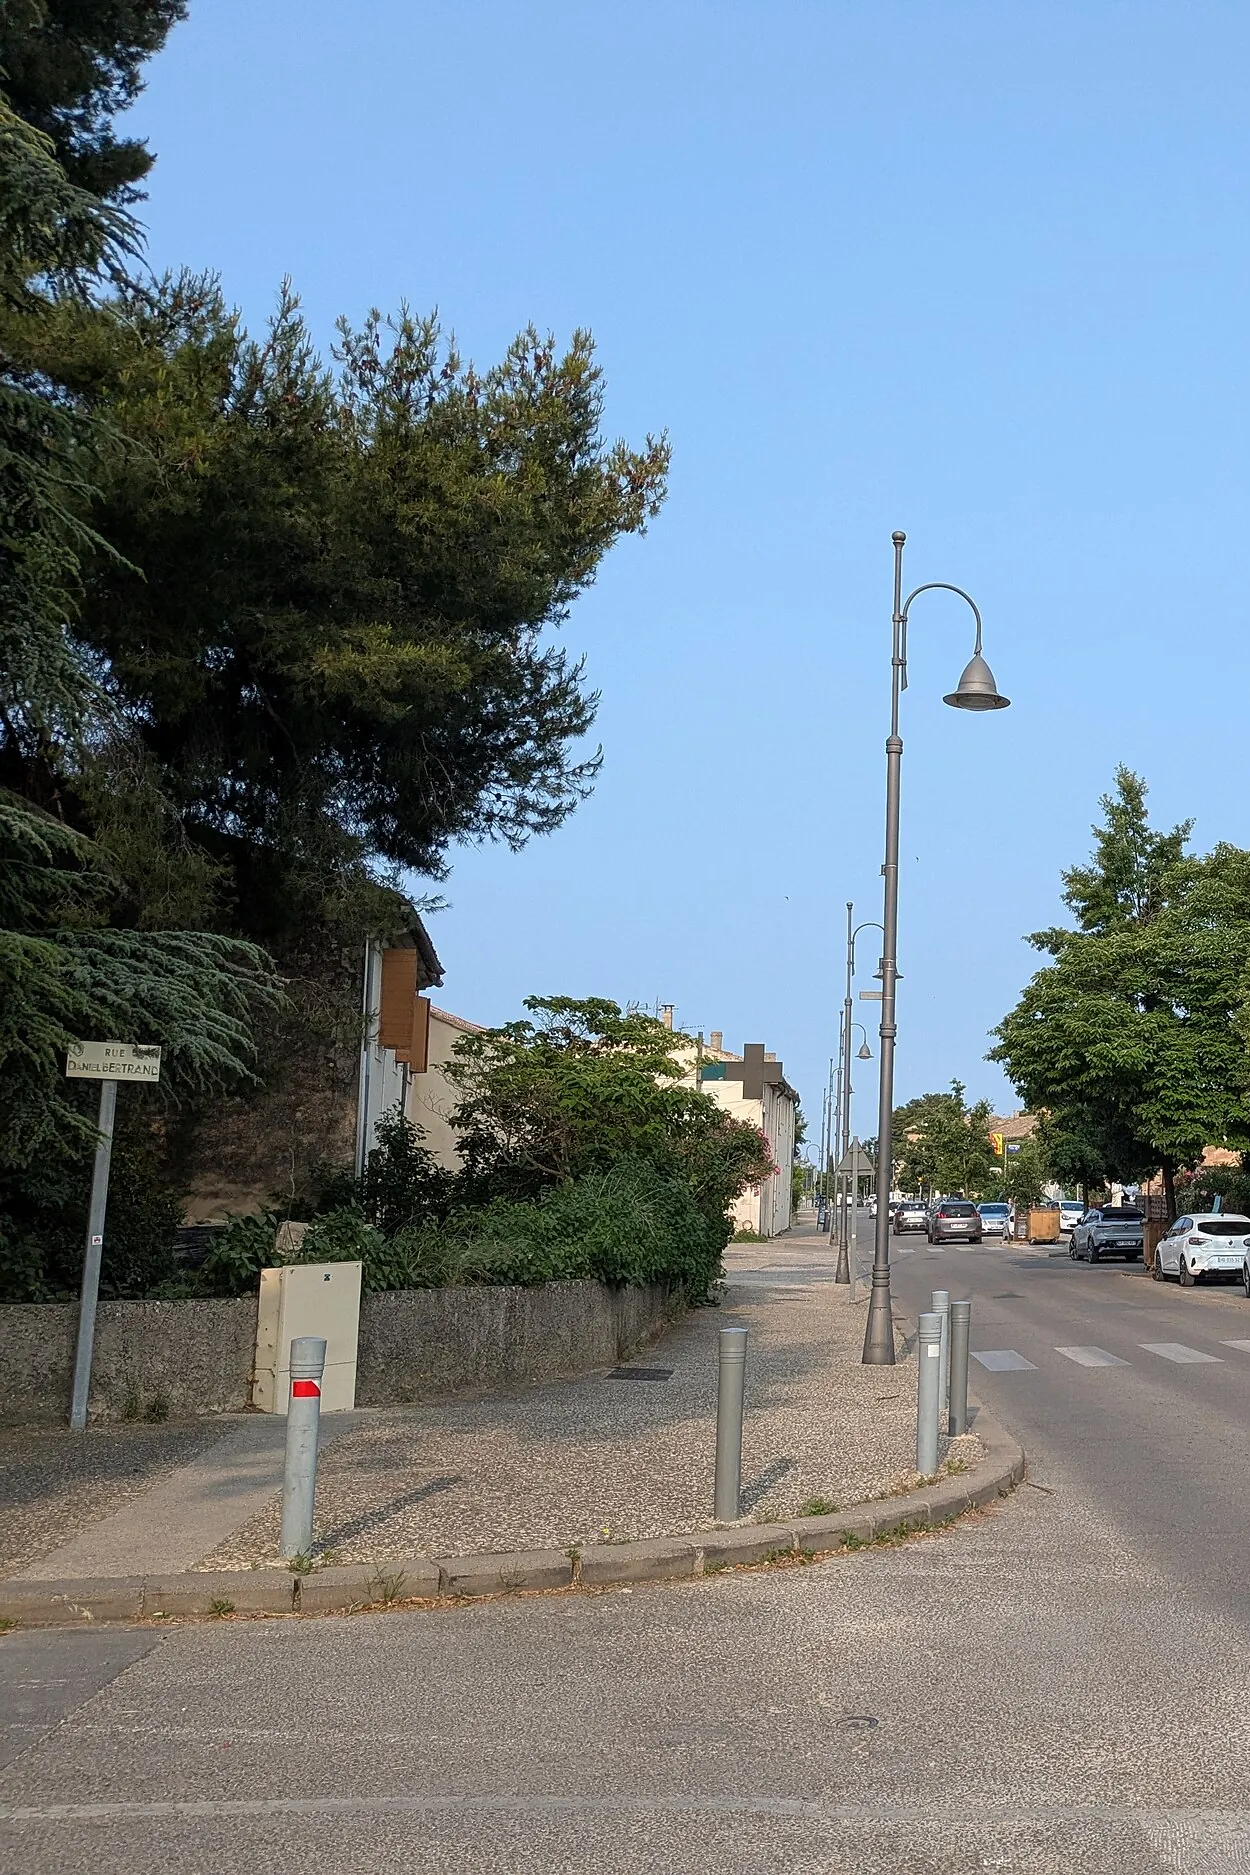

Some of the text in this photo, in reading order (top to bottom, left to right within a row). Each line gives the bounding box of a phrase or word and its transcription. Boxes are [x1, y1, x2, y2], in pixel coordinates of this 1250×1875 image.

[105, 1048, 125, 1058] RUE
[68, 1060, 158, 1076] DANIEL BERTRAND
